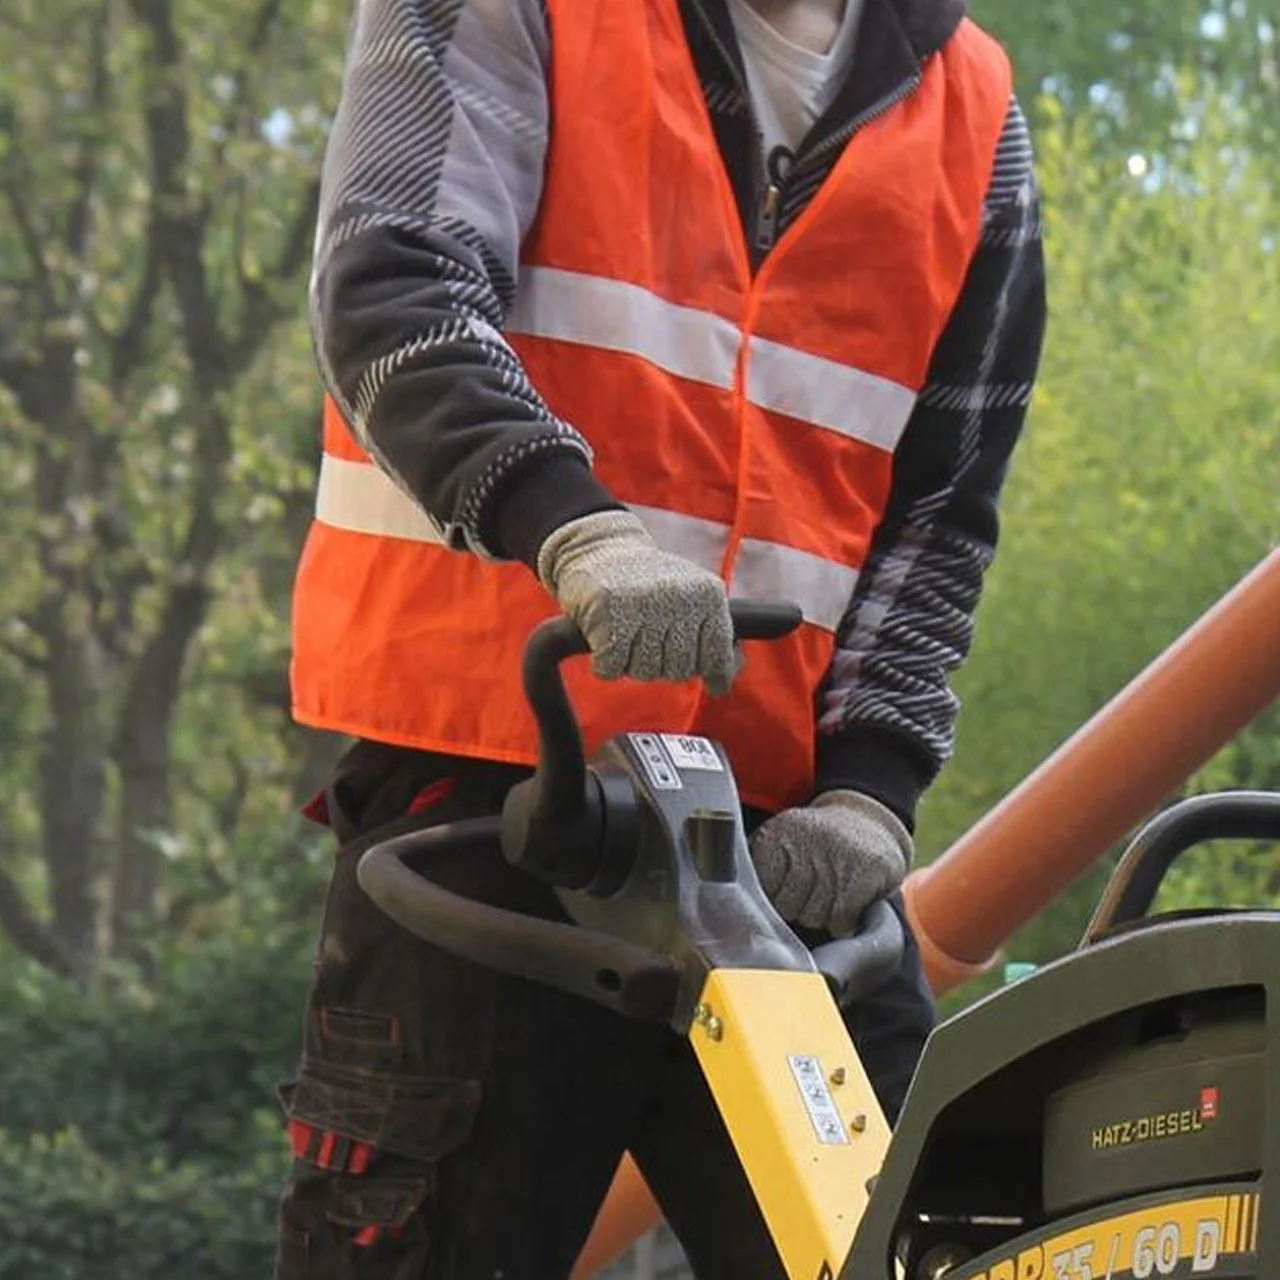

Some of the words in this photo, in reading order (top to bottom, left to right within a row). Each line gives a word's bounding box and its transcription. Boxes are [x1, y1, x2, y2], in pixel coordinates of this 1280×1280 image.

[1092, 1110, 1202, 1149] HATZ-DIESEL
[1133, 1221, 1181, 1279] 60
[1192, 1219, 1221, 1273] D
